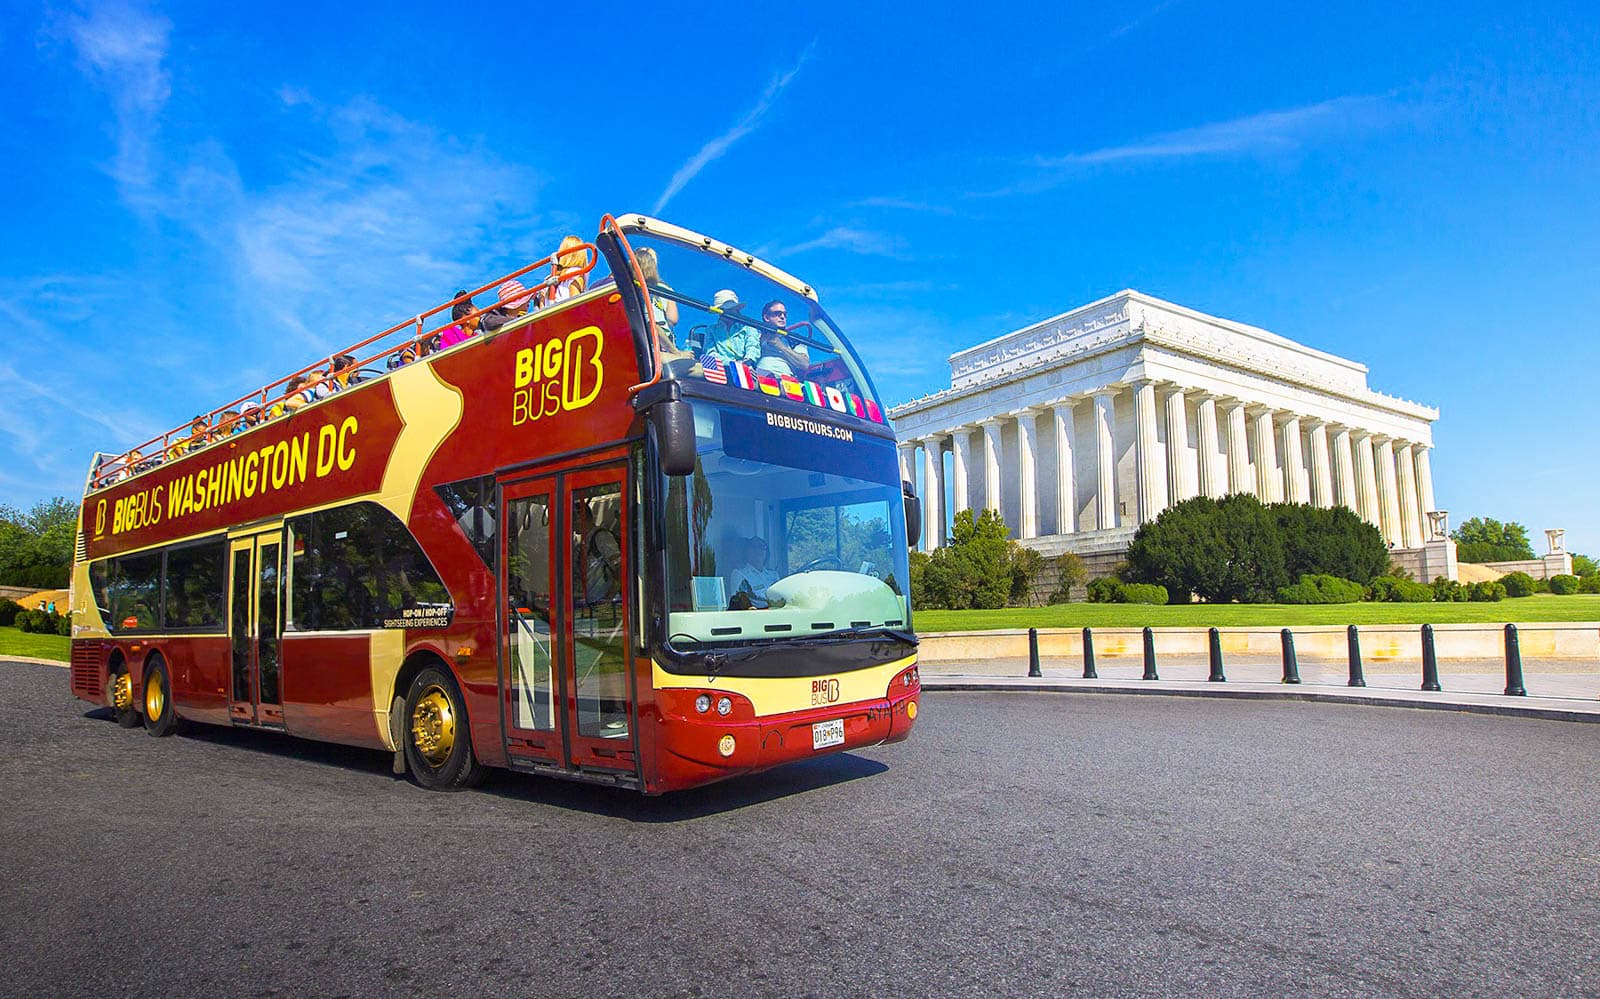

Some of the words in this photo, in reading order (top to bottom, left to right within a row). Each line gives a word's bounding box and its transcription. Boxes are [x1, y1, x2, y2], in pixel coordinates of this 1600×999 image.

[515, 338, 563, 389] BIG
[513, 380, 560, 426] BUS
[766, 412, 854, 442] BIGBUSTOURS.COM
[168, 431, 310, 519] WASHINGTON
[316, 415, 358, 478] DC
[414, 617, 448, 627] EXPERIENCES
[811, 693, 827, 706] BUS
[812, 680, 827, 693] BIG
